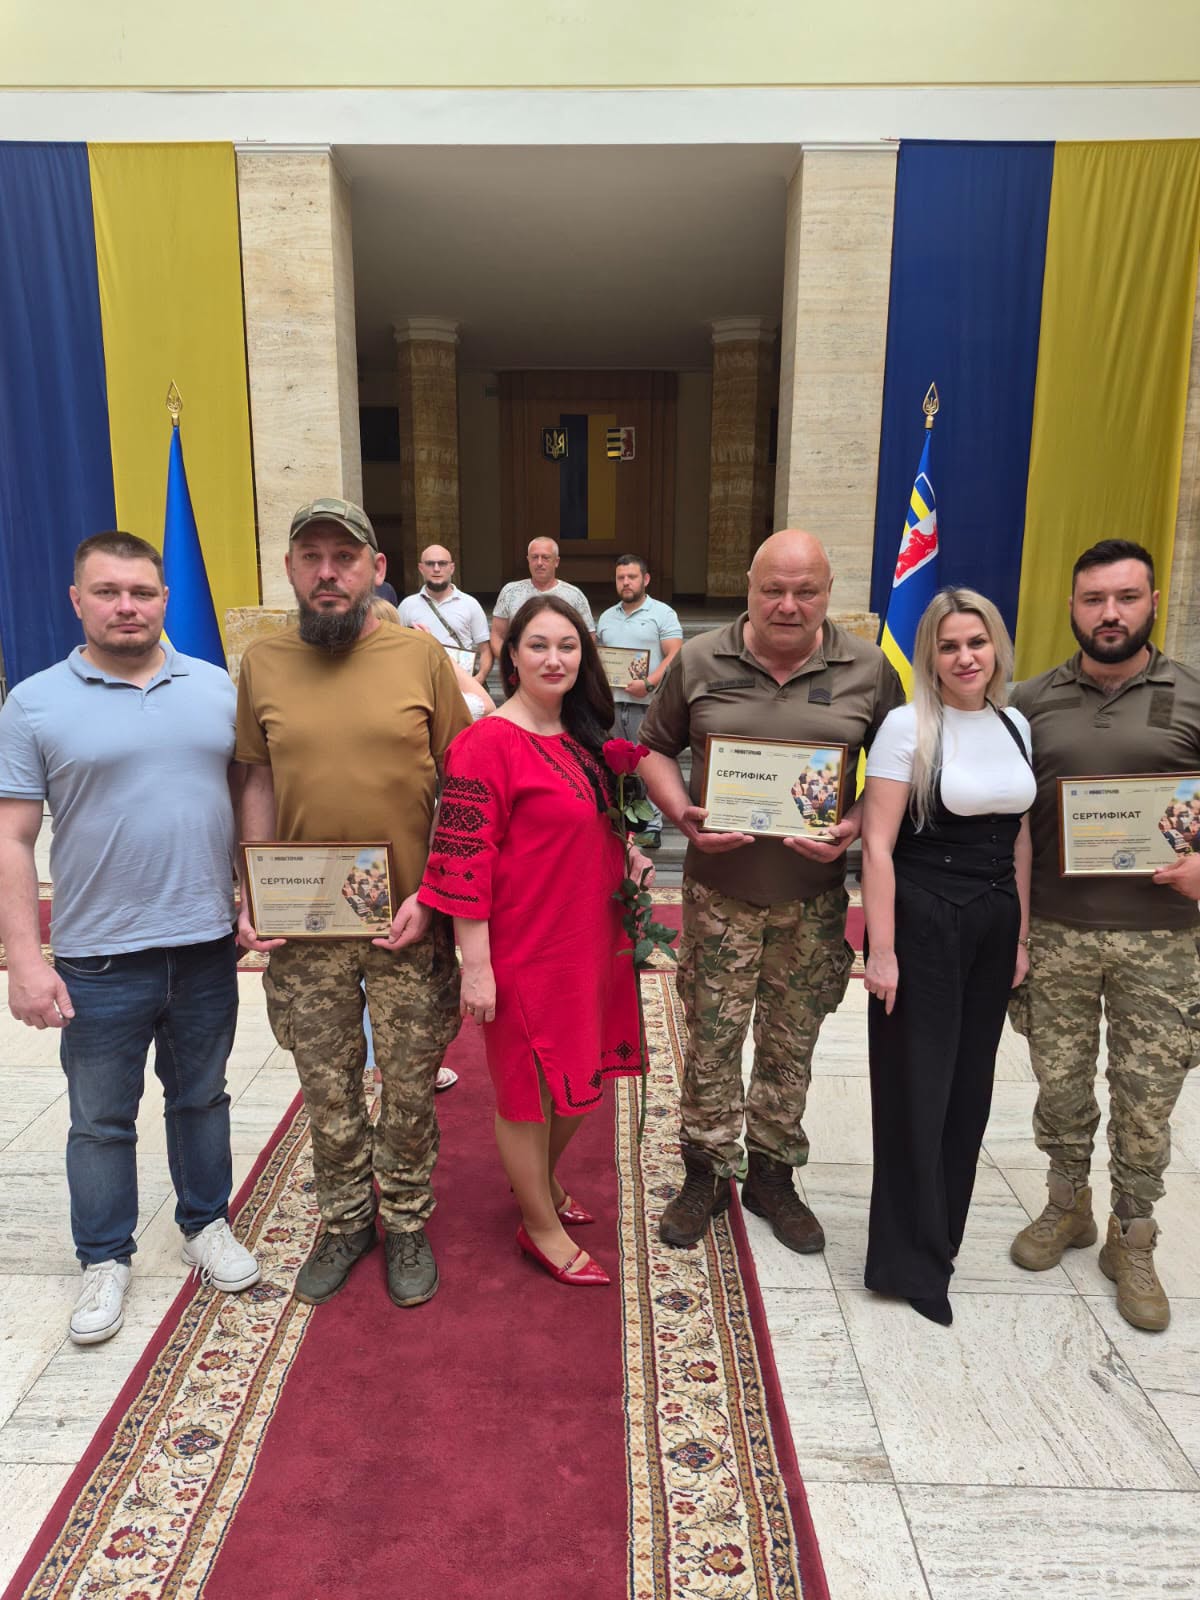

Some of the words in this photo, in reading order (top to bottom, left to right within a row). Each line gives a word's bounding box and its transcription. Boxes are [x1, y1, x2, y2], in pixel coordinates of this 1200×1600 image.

[716, 769, 778, 782] СЕРТИФІКАТ
[1072, 810, 1141, 820] СЕРТИФІКАТ
[260, 877, 326, 885] СЕРТИФІКАТ
